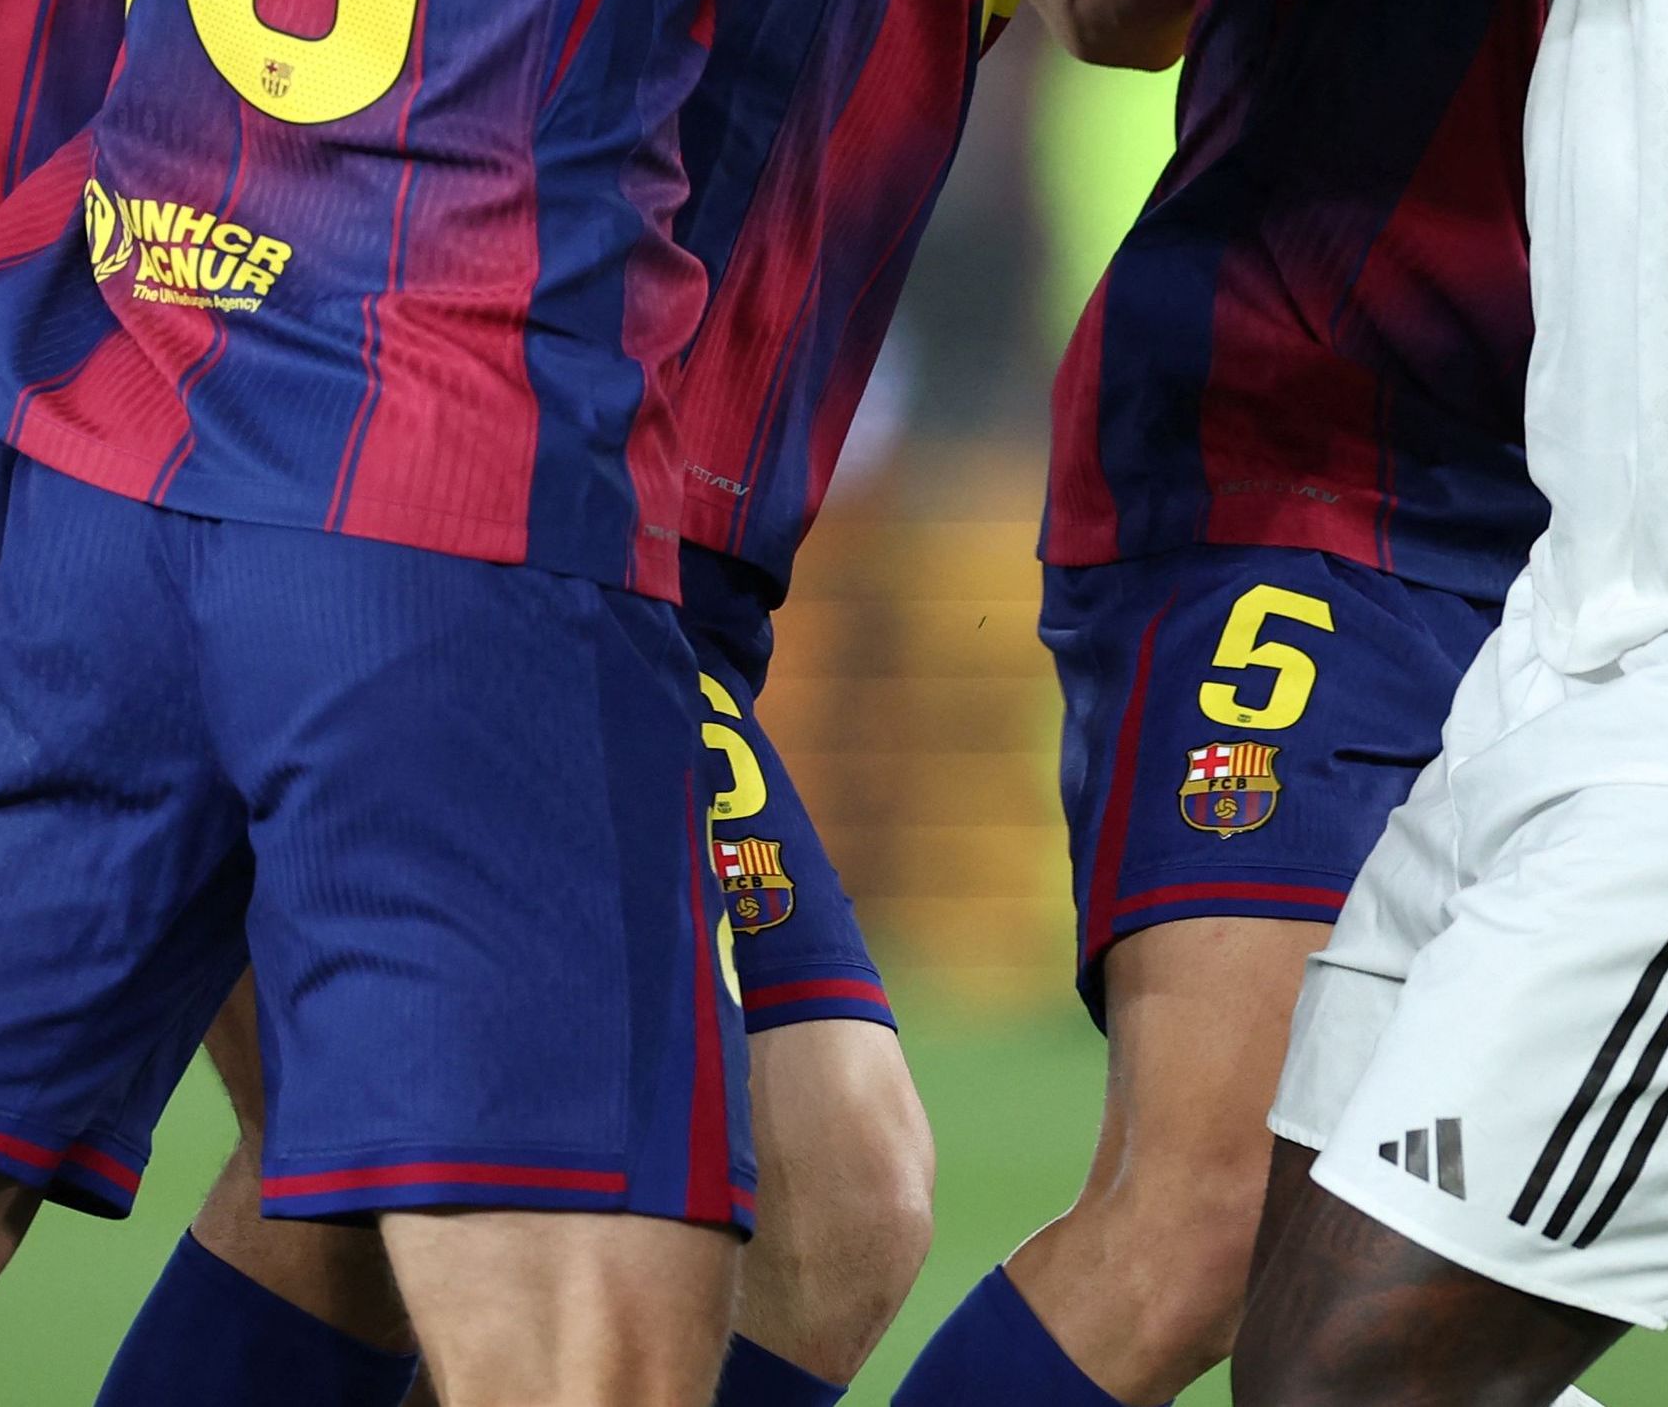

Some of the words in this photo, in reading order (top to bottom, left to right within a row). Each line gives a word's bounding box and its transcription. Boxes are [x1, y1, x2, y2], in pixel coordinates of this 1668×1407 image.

[121, 198, 293, 275] UNHCR
[135, 242, 276, 296] ACNUR
[132, 283, 163, 304] The
[1198, 583, 1335, 730] 5
[1208, 778, 1248, 792] FCB
[722, 876, 763, 891] FCB
